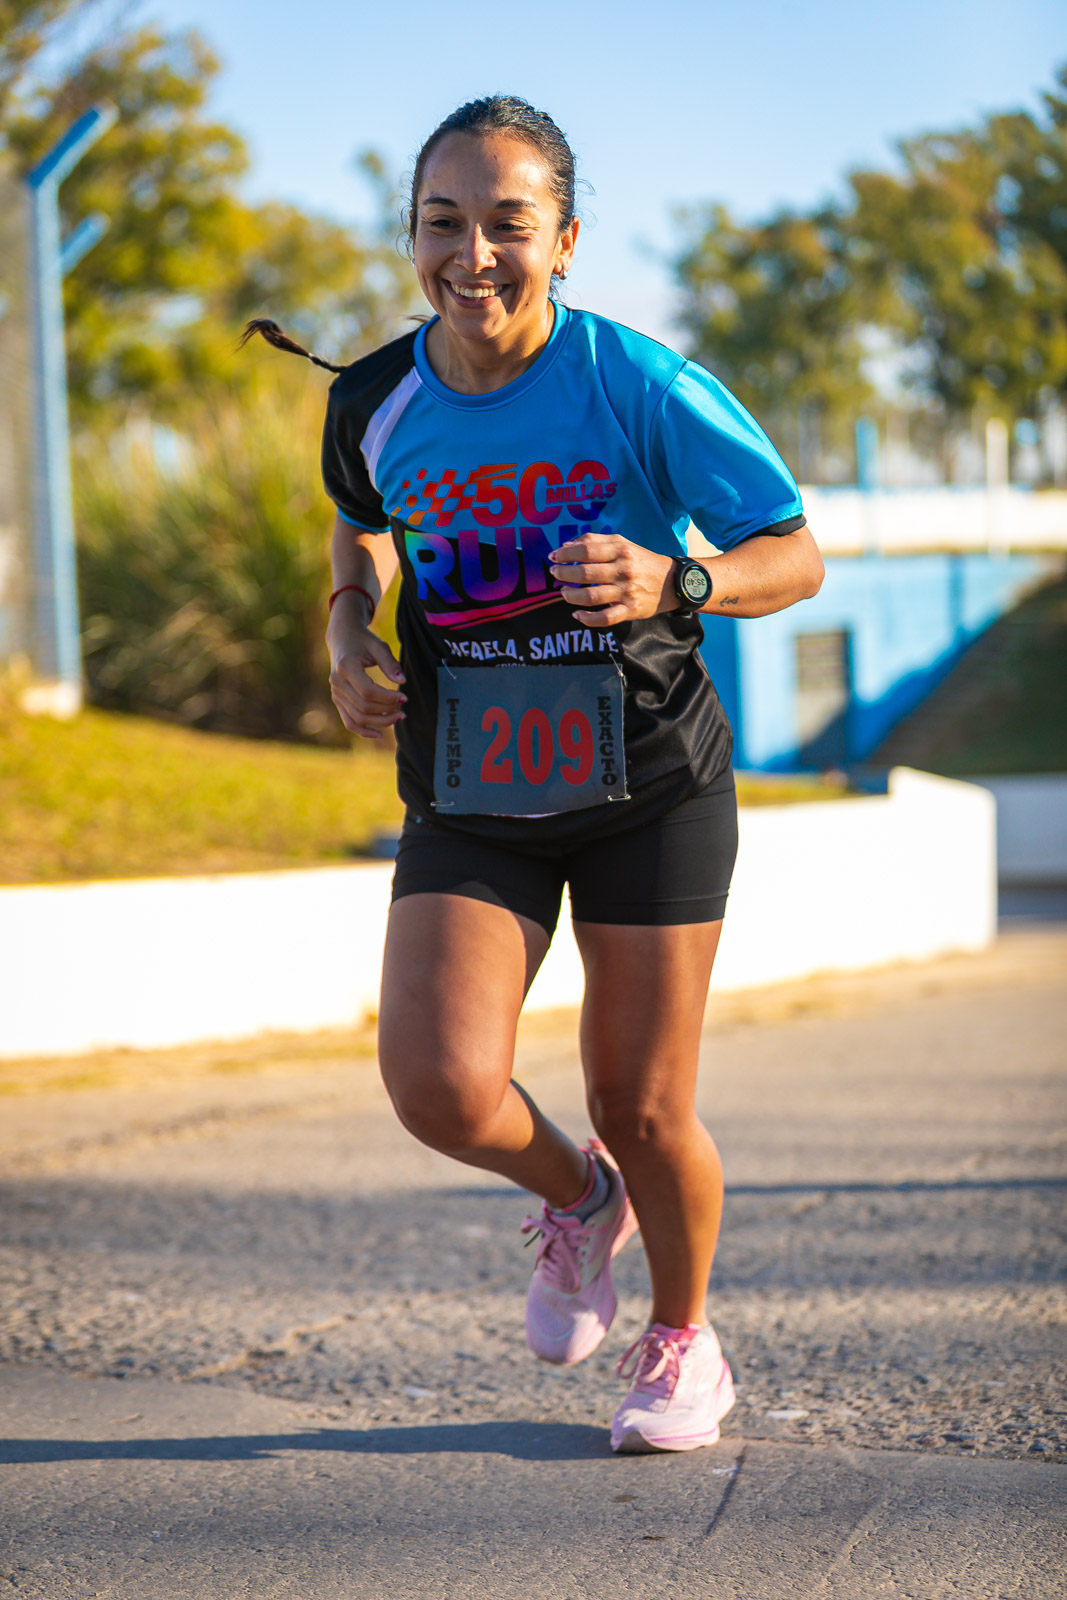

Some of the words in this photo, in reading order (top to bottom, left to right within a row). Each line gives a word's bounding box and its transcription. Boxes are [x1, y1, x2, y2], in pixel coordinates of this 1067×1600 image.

[471, 460, 610, 527] 500
[546, 482, 617, 505] MILLAS
[529, 629, 594, 660] SANTA
[597, 631, 619, 653] FE
[446, 698, 462, 788] TIEMPO
[480, 706, 594, 785] 209
[597, 696, 617, 786] EXACTO
